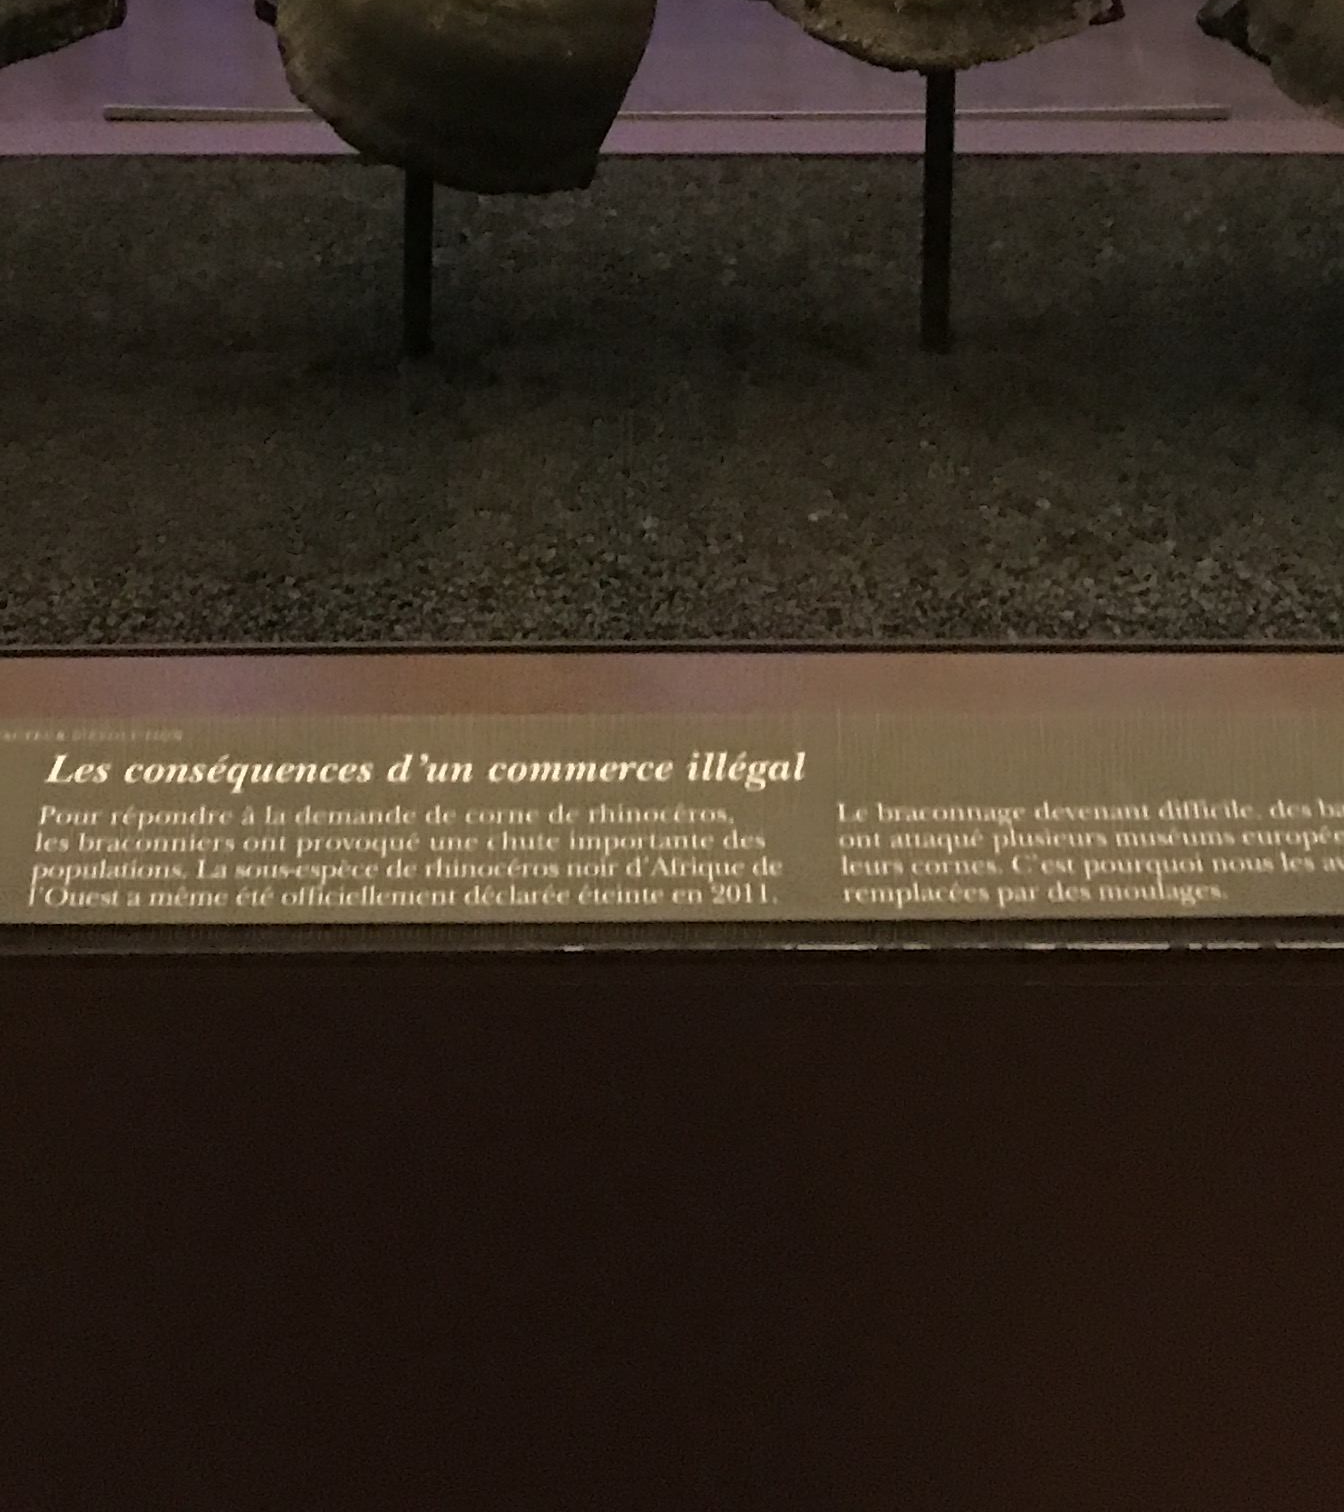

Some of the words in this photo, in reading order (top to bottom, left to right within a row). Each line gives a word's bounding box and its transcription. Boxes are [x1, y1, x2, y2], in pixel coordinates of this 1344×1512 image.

[44, 753, 112, 784] Les
[124, 753, 374, 795] conséquences
[387, 752, 474, 784] d'un
[488, 759, 674, 784] commerce
[687, 750, 807, 793] illégal
[38, 804, 101, 826] Pour
[110, 804, 233, 831] répondre
[241, 804, 256, 826] à
[265, 804, 286, 826] la
[295, 804, 417, 826] demande
[425, 803, 457, 825] de
[465, 807, 539, 825] corne
[548, 803, 580, 824] de
[588, 802, 735, 826] rhinocéros,
[837, 802, 869, 823] Le
[877, 801, 1026, 827] braconnage
[1034, 800, 1151, 822] devenant
[1269, 798, 1312, 820] des
[35, 832, 69, 853] les
[78, 832, 235, 853] braconniers
[243, 835, 287, 853] ont
[296, 832, 421, 859] provoqué
[430, 835, 479, 852] une
[486, 830, 561, 852] chute
[569, 829, 715, 858] importante
[722, 828, 767, 851] des
[838, 831, 880, 849] ont
[890, 827, 984, 855] attaqué
[992, 826, 1108, 855] plusieurs
[1115, 827, 1236, 847] muséums
[31, 857, 187, 886] populations.
[196, 858, 228, 879] La
[235, 857, 379, 886] sous-espèce
[386, 856, 419, 879] de
[425, 856, 560, 879] rhinocéros
[567, 857, 619, 878] noir
[625, 855, 746, 884] d'Afrique
[752, 855, 784, 877] de
[841, 854, 904, 876] leurs
[1011, 853, 1074, 875] C'est
[1083, 852, 1204, 882] pourquoi
[1212, 856, 1275, 874] nous
[1281, 850, 1315, 873] les
[28, 885, 120, 908] l'Ouest
[126, 891, 142, 907] a
[148, 886, 229, 907] même
[235, 885, 276, 907] été
[280, 884, 457, 907] officiellement
[464, 883, 571, 906] déclarée
[578, 882, 665, 906] éteinte
[672, 888, 703, 905] en
[711, 881, 779, 905] 2011.
[843, 880, 990, 910] remplacées
[997, 884, 1040, 909] par
[1047, 879, 1092, 903] des
[1099, 879, 1228, 907] moulages.
